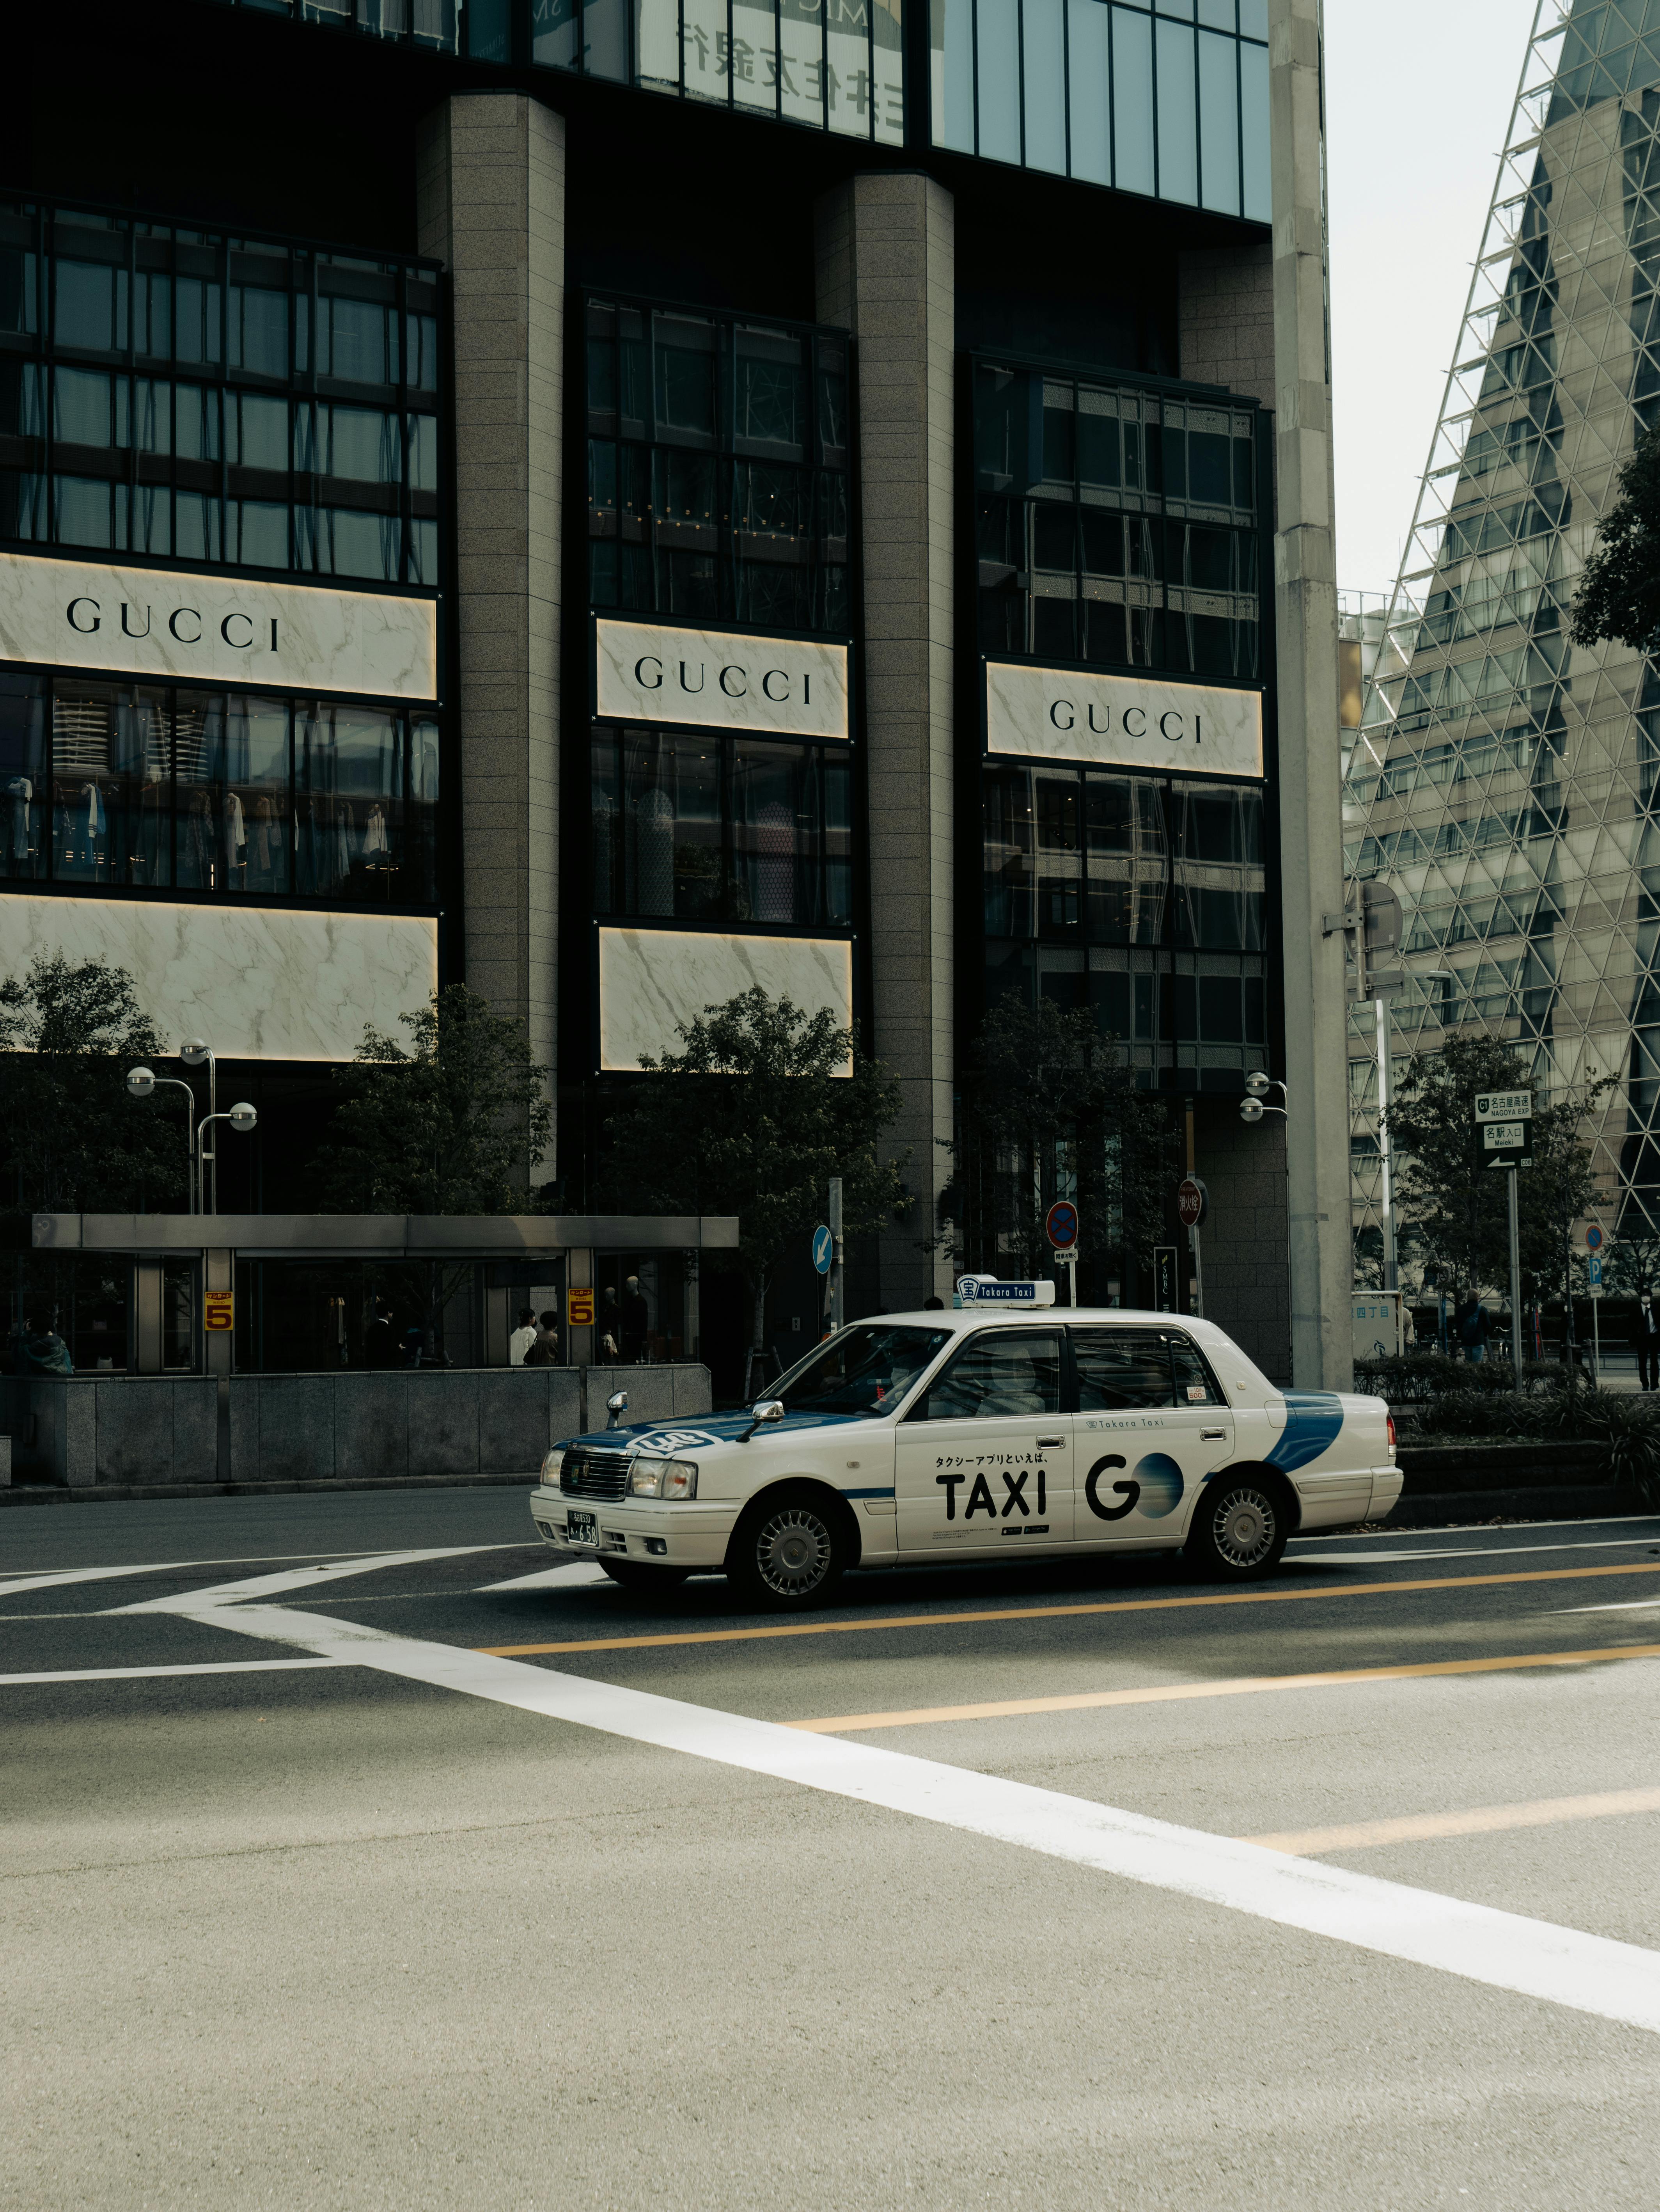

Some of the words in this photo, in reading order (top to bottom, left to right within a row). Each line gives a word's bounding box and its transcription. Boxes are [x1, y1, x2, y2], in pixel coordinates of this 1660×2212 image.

[67, 597, 278, 652] GUCCI
[635, 656, 810, 705] GUCCI
[1050, 700, 1201, 744] GUCCI
[1479, 1101, 1487, 1110] C1
[1491, 1095, 1529, 1109] 名古屋高速
[1486, 1127, 1521, 1139] 名駅入口
[1179, 1195, 1198, 1211] 消火栓
[1592, 1261, 1599, 1282] P
[981, 1287, 1010, 1296] Takara
[1014, 1287, 1032, 1296] Taxi
[206, 1305, 232, 1329] 5
[570, 1301, 592, 1324] 5
[1351, 1306, 1389, 1319] 四丁目
[1099, 1420, 1136, 1428] Takara
[1141, 1418, 1163, 1426] Taxi
[936, 1452, 1047, 1468] タクシーアプリといえば、
[936, 1470, 1046, 1521] TAXI
